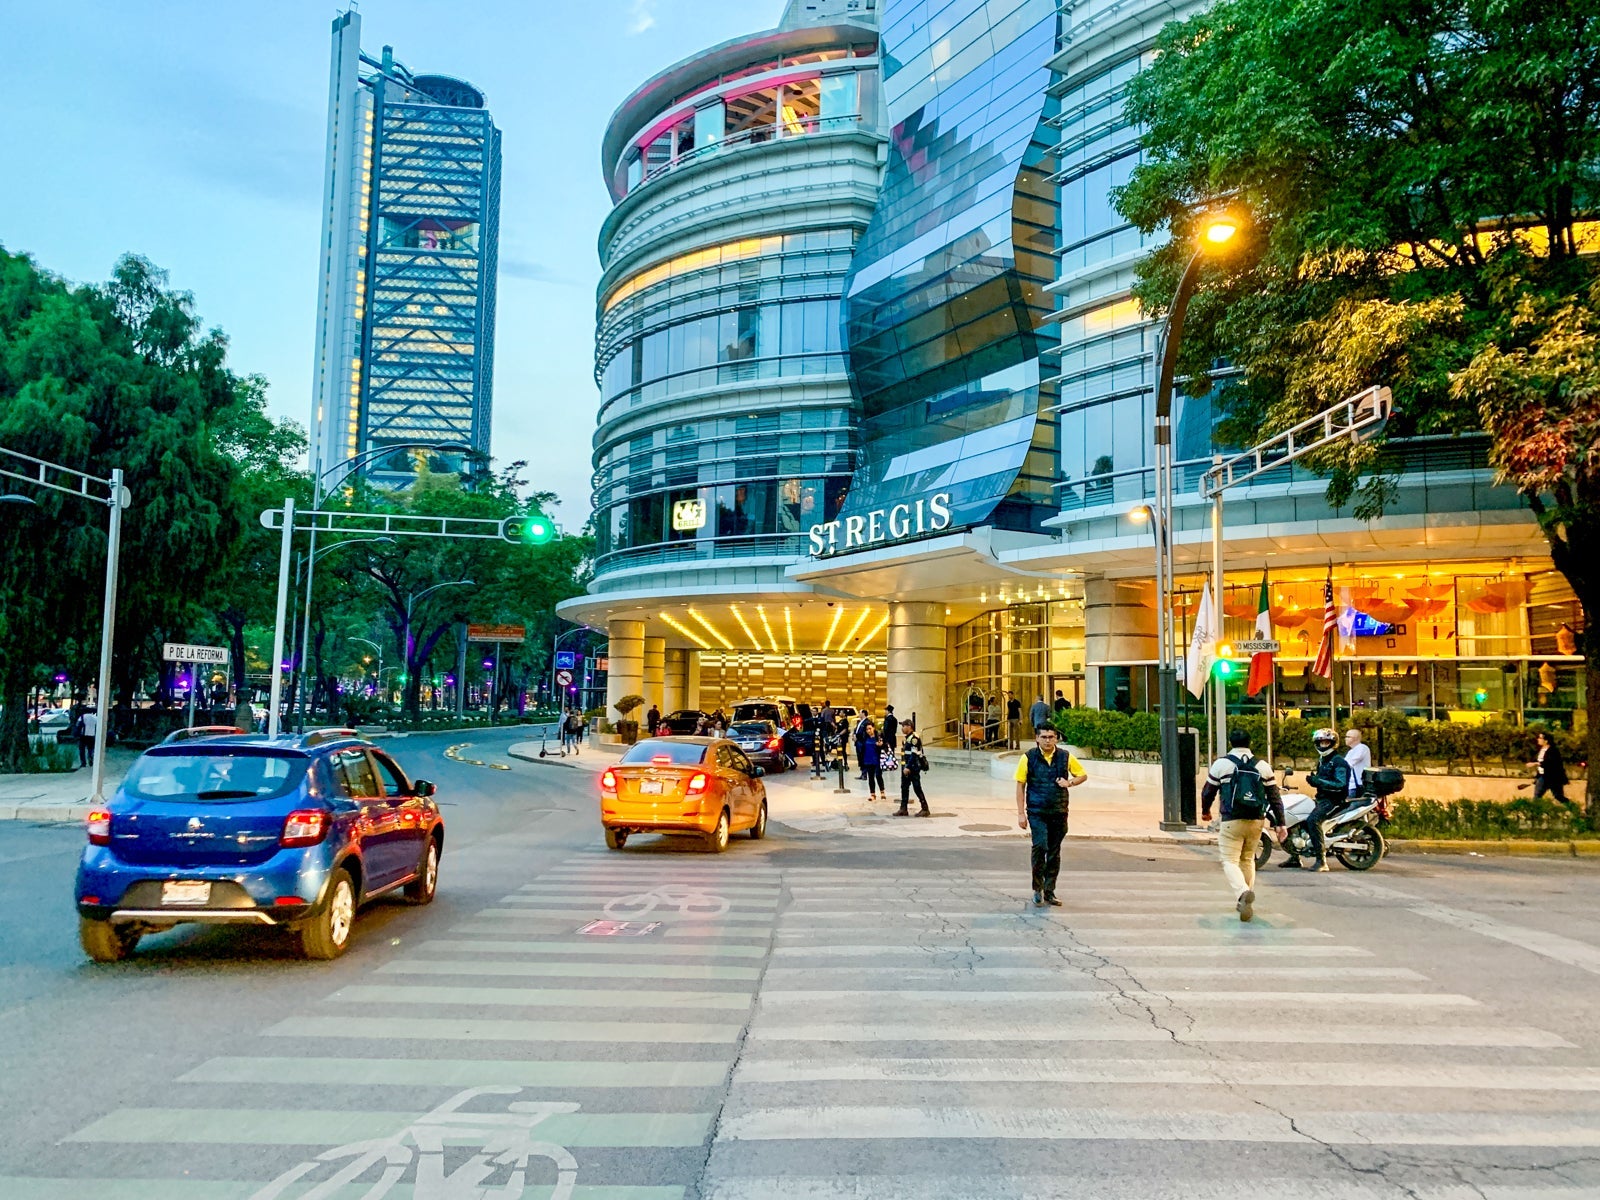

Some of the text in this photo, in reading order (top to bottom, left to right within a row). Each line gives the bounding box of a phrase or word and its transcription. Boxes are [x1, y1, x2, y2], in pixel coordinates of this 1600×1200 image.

[845, 493, 951, 548] REGIS
[169, 646, 223, 661] P DE LA REFORMA
